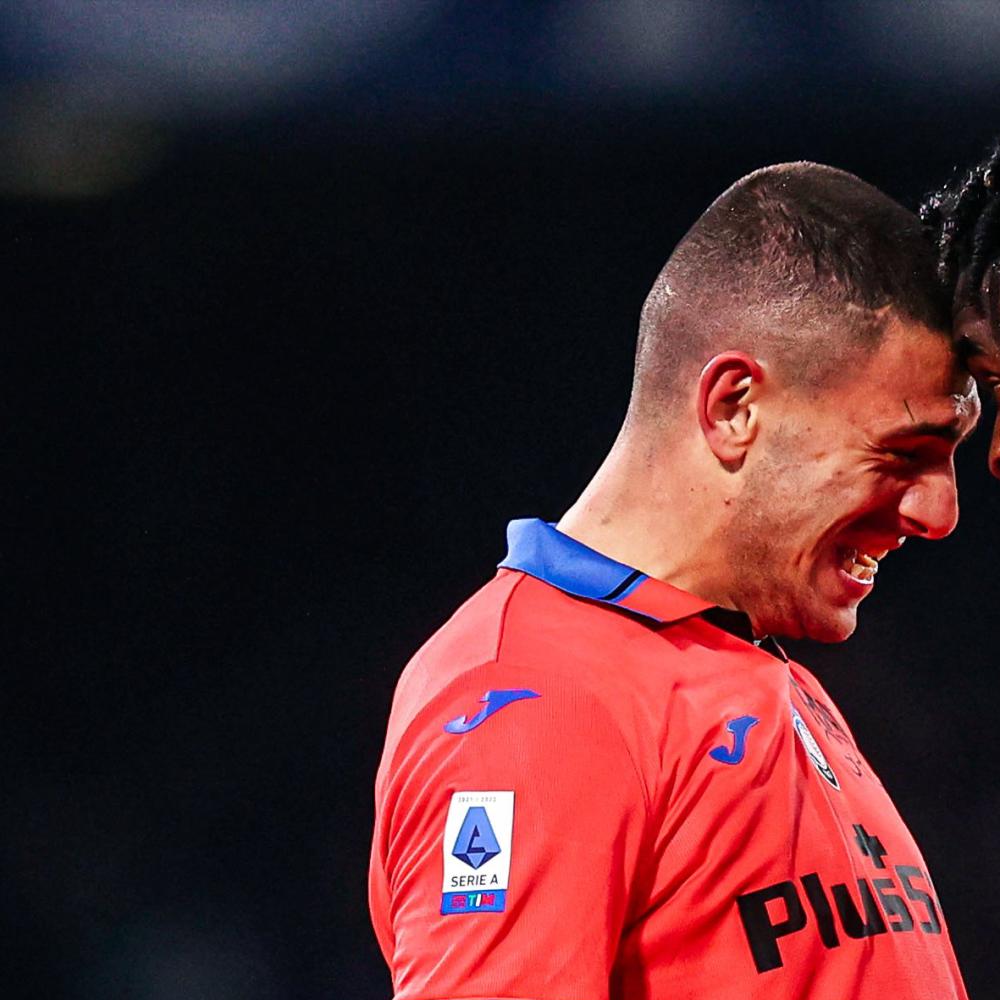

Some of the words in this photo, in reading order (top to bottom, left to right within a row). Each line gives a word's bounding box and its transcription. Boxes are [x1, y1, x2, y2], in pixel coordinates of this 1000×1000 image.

[451, 874, 486, 888] SERIE
[490, 873, 499, 886] A
[736, 865, 945, 975] Plus5
